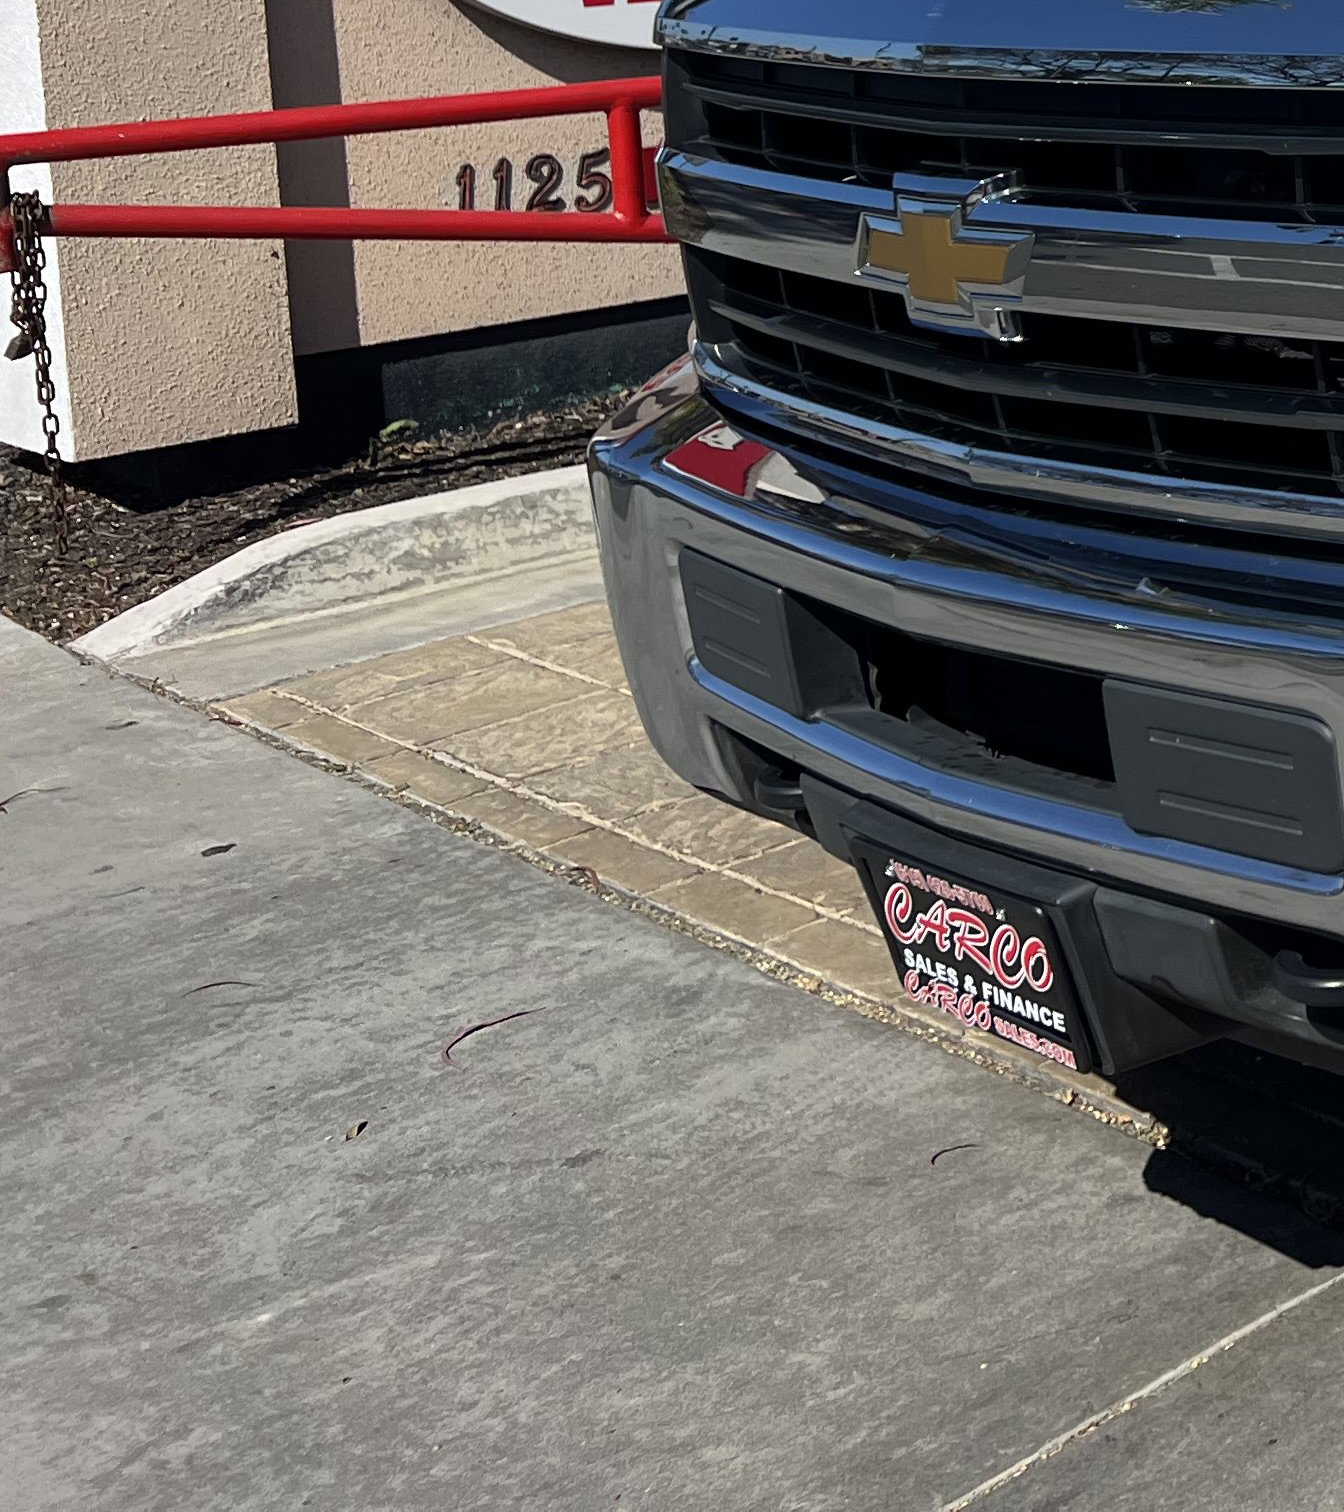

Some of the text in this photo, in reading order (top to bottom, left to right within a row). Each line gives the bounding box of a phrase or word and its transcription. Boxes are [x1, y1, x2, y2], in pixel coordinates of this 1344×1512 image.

[456, 147, 613, 212] 1125
[884, 882, 1053, 992] CARCO
[903, 948, 1066, 1033] SALES & FINANCE
